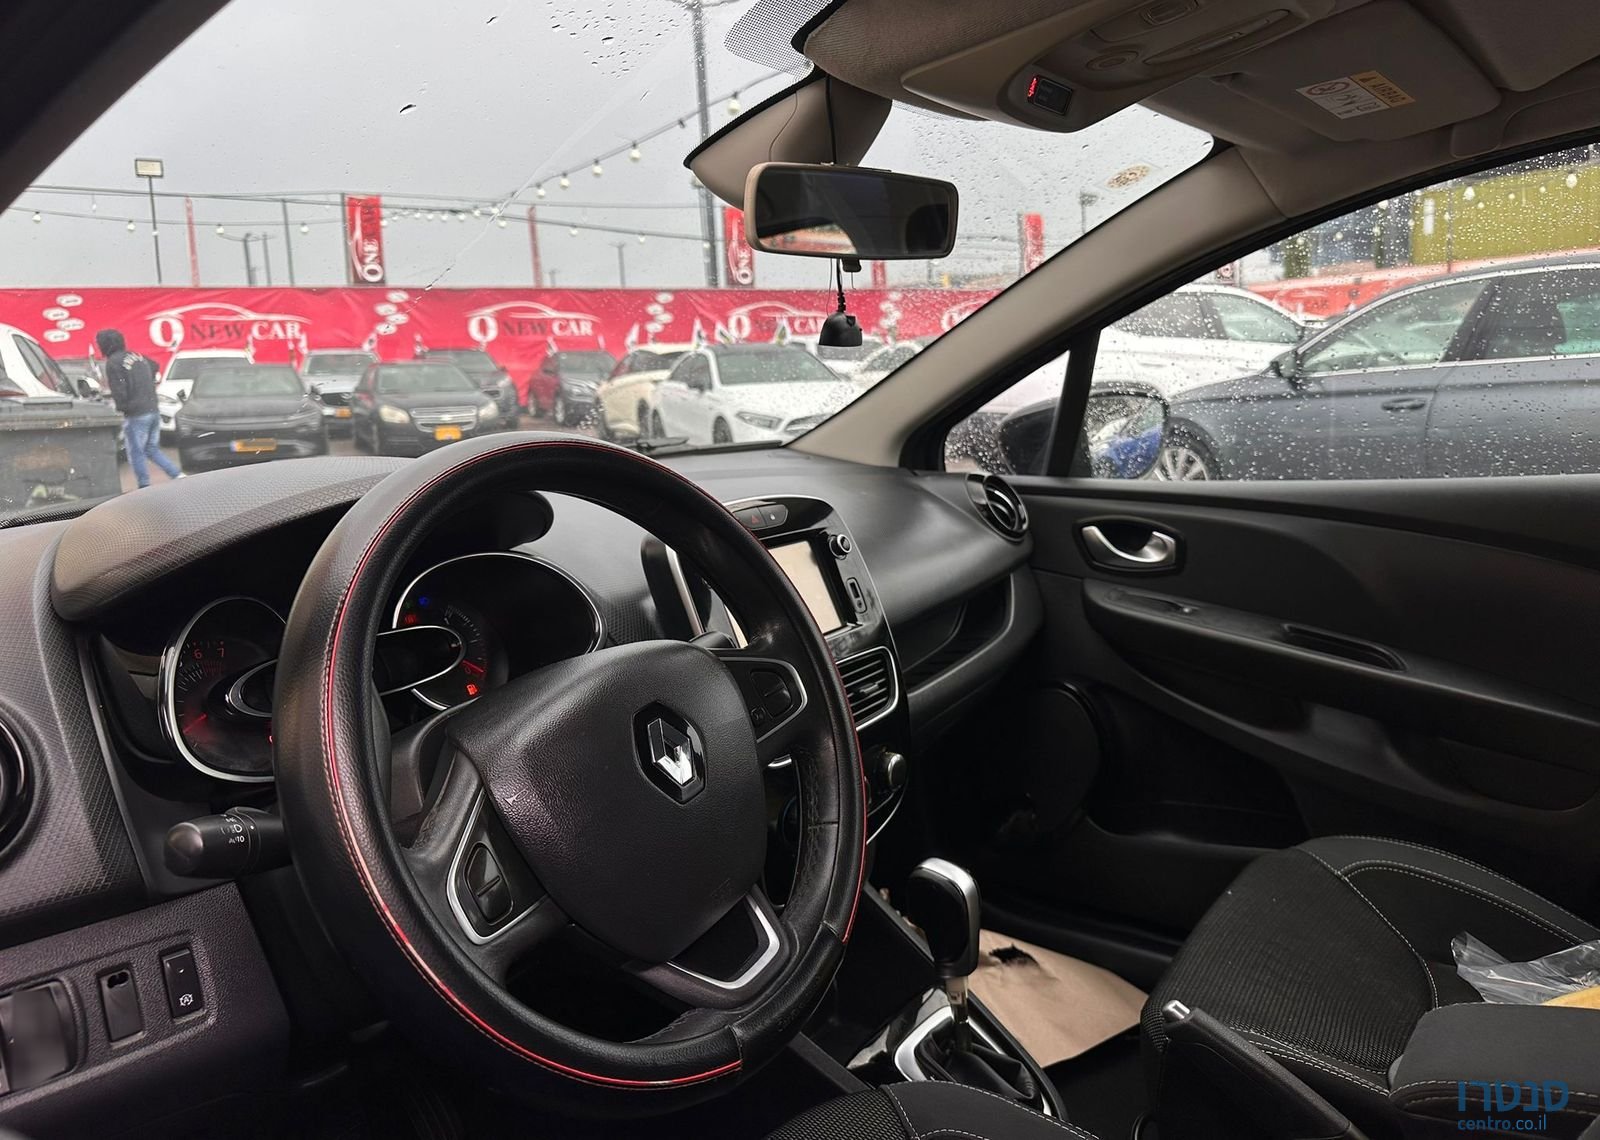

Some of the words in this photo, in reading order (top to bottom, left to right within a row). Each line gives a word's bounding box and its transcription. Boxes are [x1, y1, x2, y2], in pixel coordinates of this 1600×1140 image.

[362, 239, 384, 283] ONE
[251, 321, 302, 340] CAR
[551, 319, 593, 337] CAR
